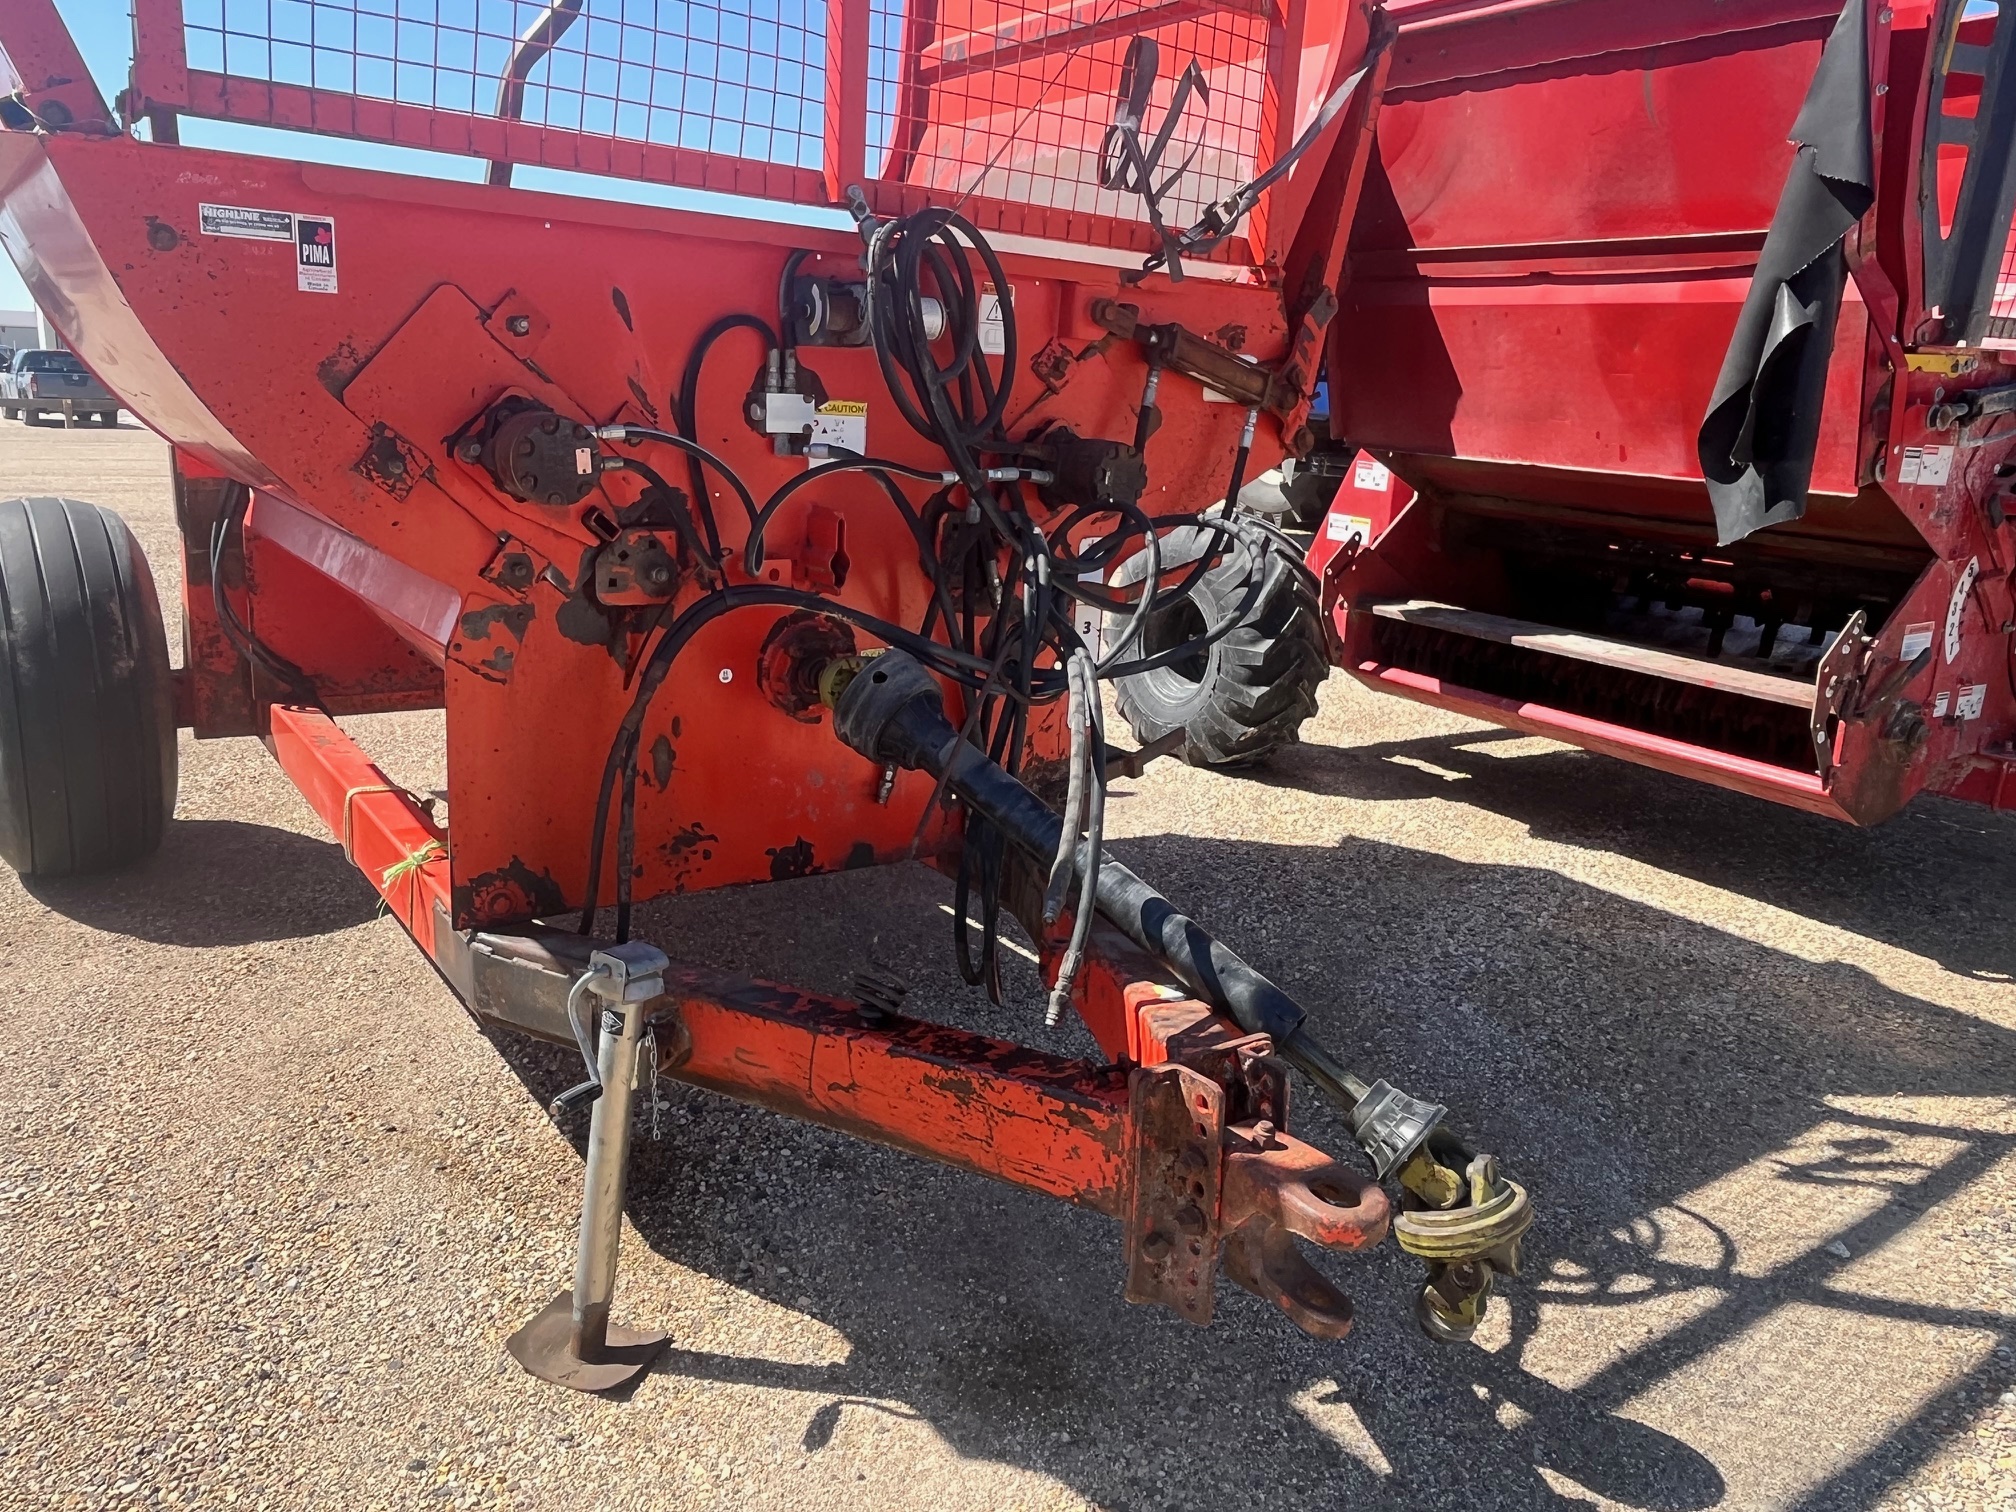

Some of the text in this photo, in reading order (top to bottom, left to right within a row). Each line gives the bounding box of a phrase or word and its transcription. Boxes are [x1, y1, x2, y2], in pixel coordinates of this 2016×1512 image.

[202, 206, 261, 221] HIGHLINE
[302, 243, 330, 264] PIMA
[824, 403, 865, 414] CAUTION
[1967, 562, 1975, 578] 5
[1951, 601, 1958, 617] 3
[1082, 620, 1092, 635] 3
[1948, 622, 1955, 637] 2
